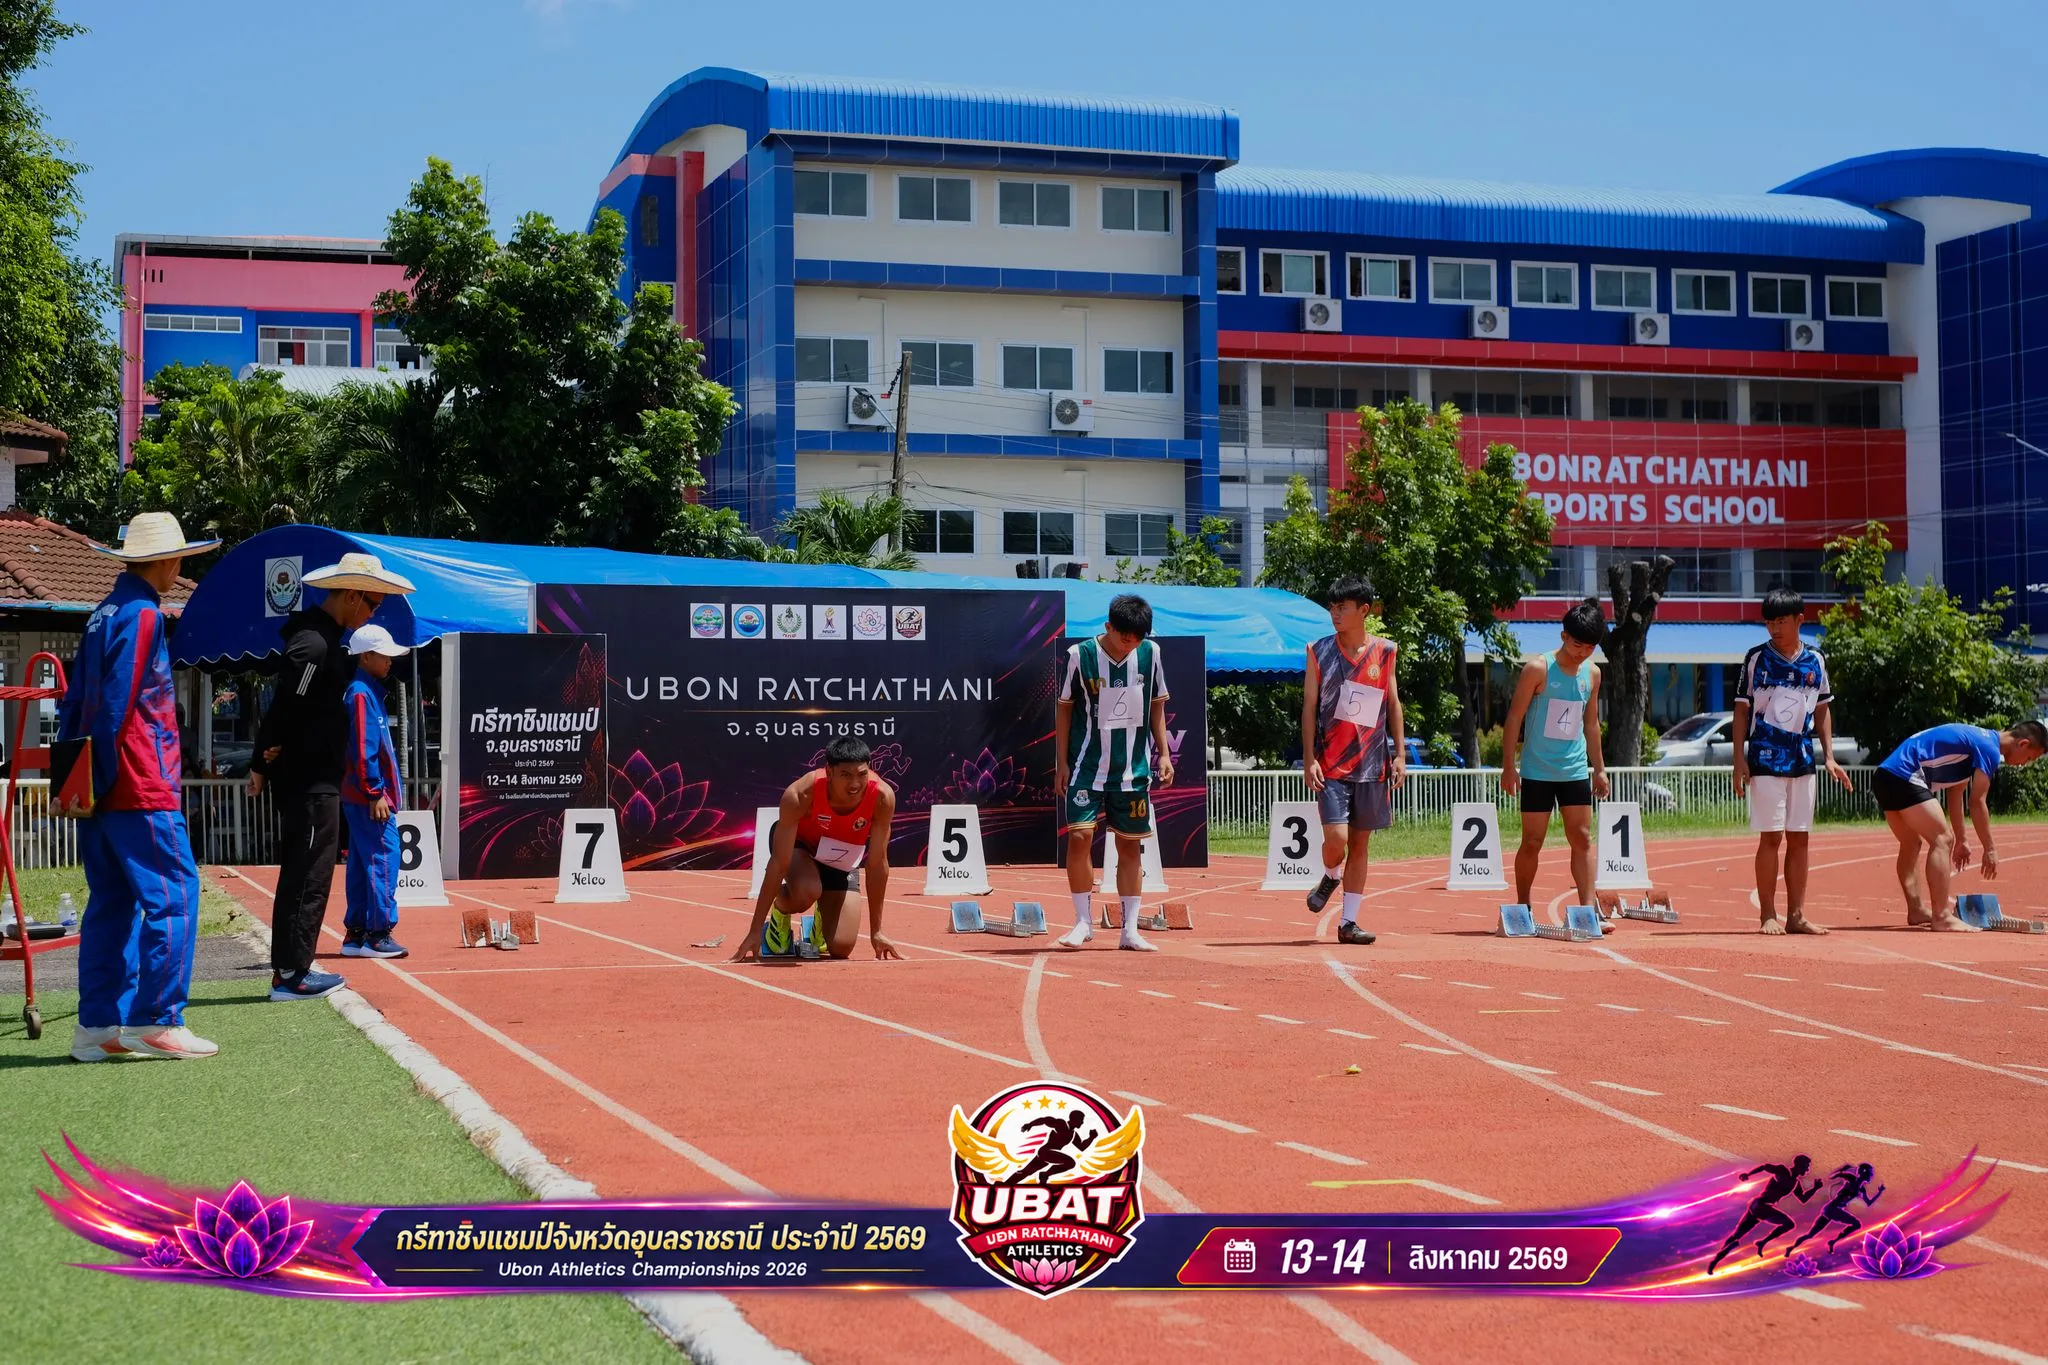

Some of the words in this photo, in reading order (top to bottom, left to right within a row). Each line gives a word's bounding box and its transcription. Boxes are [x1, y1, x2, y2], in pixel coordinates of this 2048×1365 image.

[1511, 451, 1808, 489] BONRATCHATHANI
[1665, 494, 1785, 525] SCHOOL
[626, 676, 738, 702] UBON
[757, 676, 994, 702] RATCHATHANI
[1113, 690, 1128, 717] 6
[1345, 690, 1365, 717] 5
[1773, 695, 1800, 724] 3
[469, 706, 601, 733] กรีฑาชิงแชมป์
[726, 716, 896, 743] จ.อุบลราชธานี
[1557, 708, 1572, 733] 4
[485, 734, 582, 758] จ.อุบลราชธานี
[538, 759, 555, 767] 2569
[520, 773, 557, 785] สิงหาคม
[559, 774, 583, 785] 2569
[1128, 799, 1148, 818] 10
[399, 823, 423, 872] 8
[574, 822, 606, 870] 7
[941, 817, 969, 864] 5
[1281, 815, 1310, 860] 3
[1461, 816, 1489, 860] 2
[1611, 815, 1631, 859] 1
[572, 872, 605, 887] Nelco
[938, 866, 970, 879] Nelco
[1277, 862, 1310, 876] Nelco
[1459, 863, 1490, 877] Nelco
[1605, 859, 1635, 873] Nelco
[397, 874, 425, 888] elco
